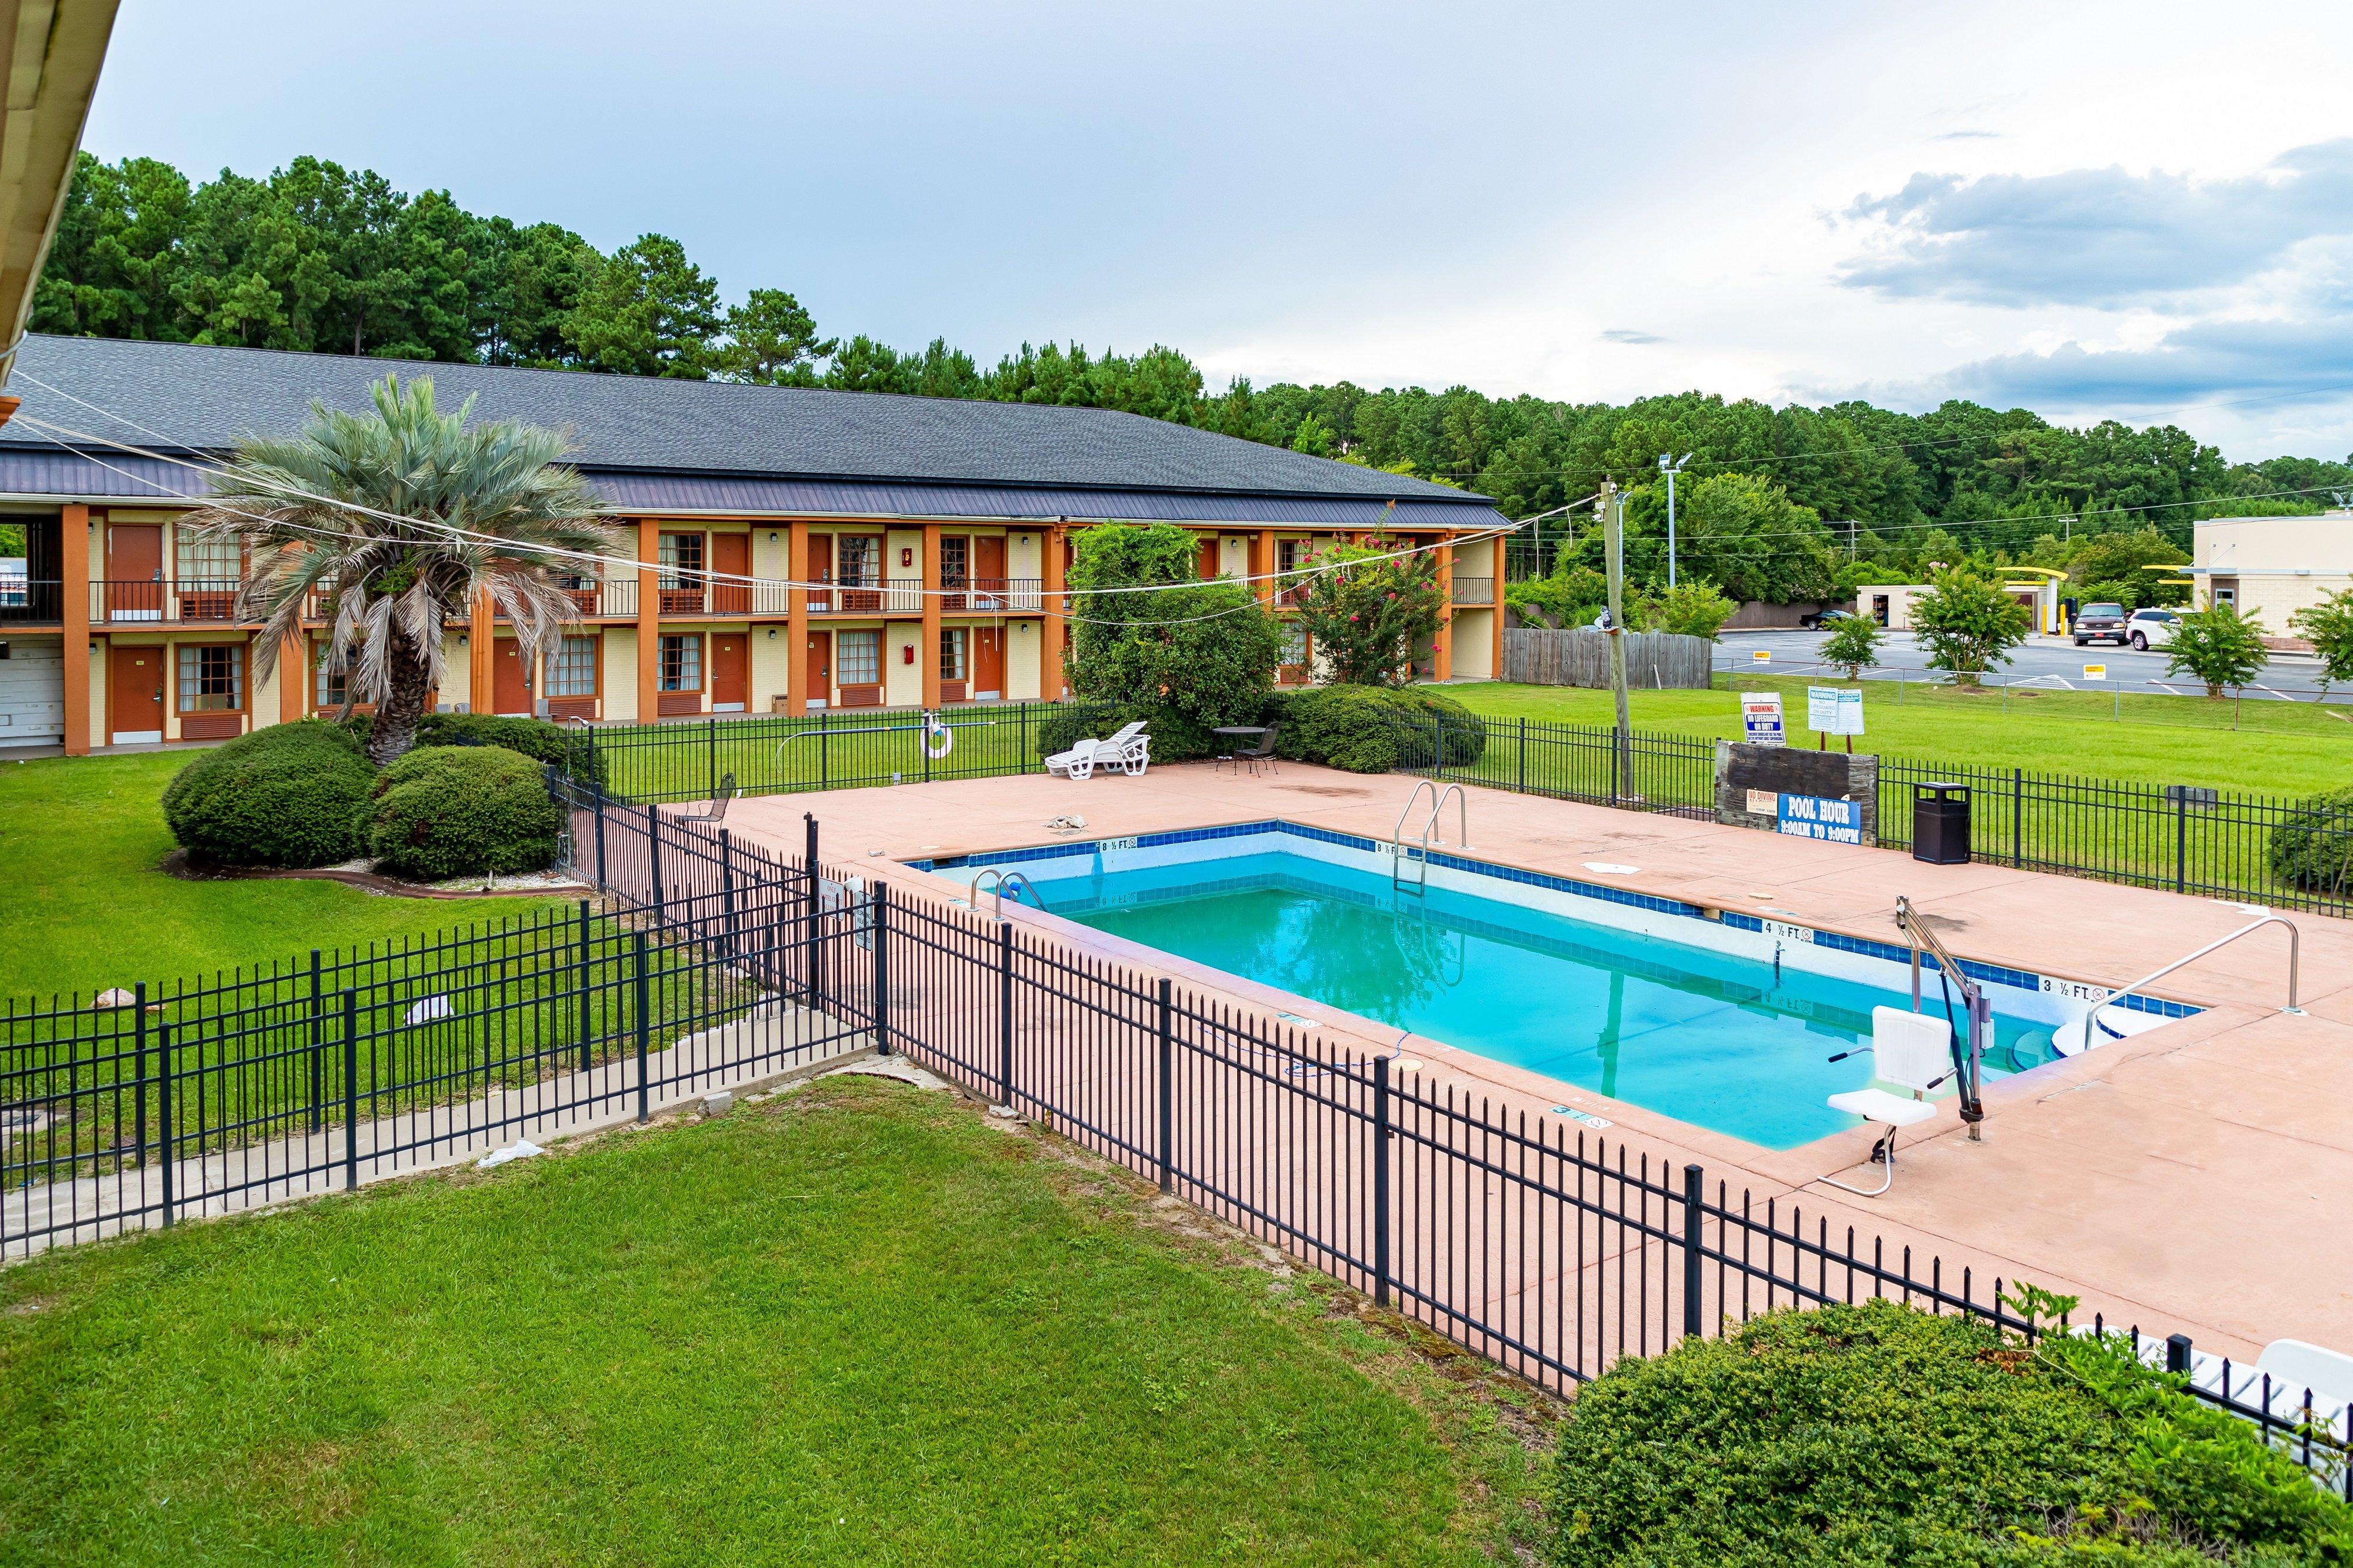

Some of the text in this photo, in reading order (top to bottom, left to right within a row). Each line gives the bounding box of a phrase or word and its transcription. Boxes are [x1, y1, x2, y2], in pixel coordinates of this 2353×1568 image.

[1811, 691, 1835, 700] WARNING
[1749, 790, 1755, 799] NO
[1758, 792, 1775, 801] DIVING
[1788, 796, 1849, 825] POOL HOUR
[1781, 819, 1859, 843] 9:00AM TO 9:00PM
[1102, 843, 1107, 851] 8
[1765, 922, 1771, 933] 4
[2044, 980, 2051, 992] 3
